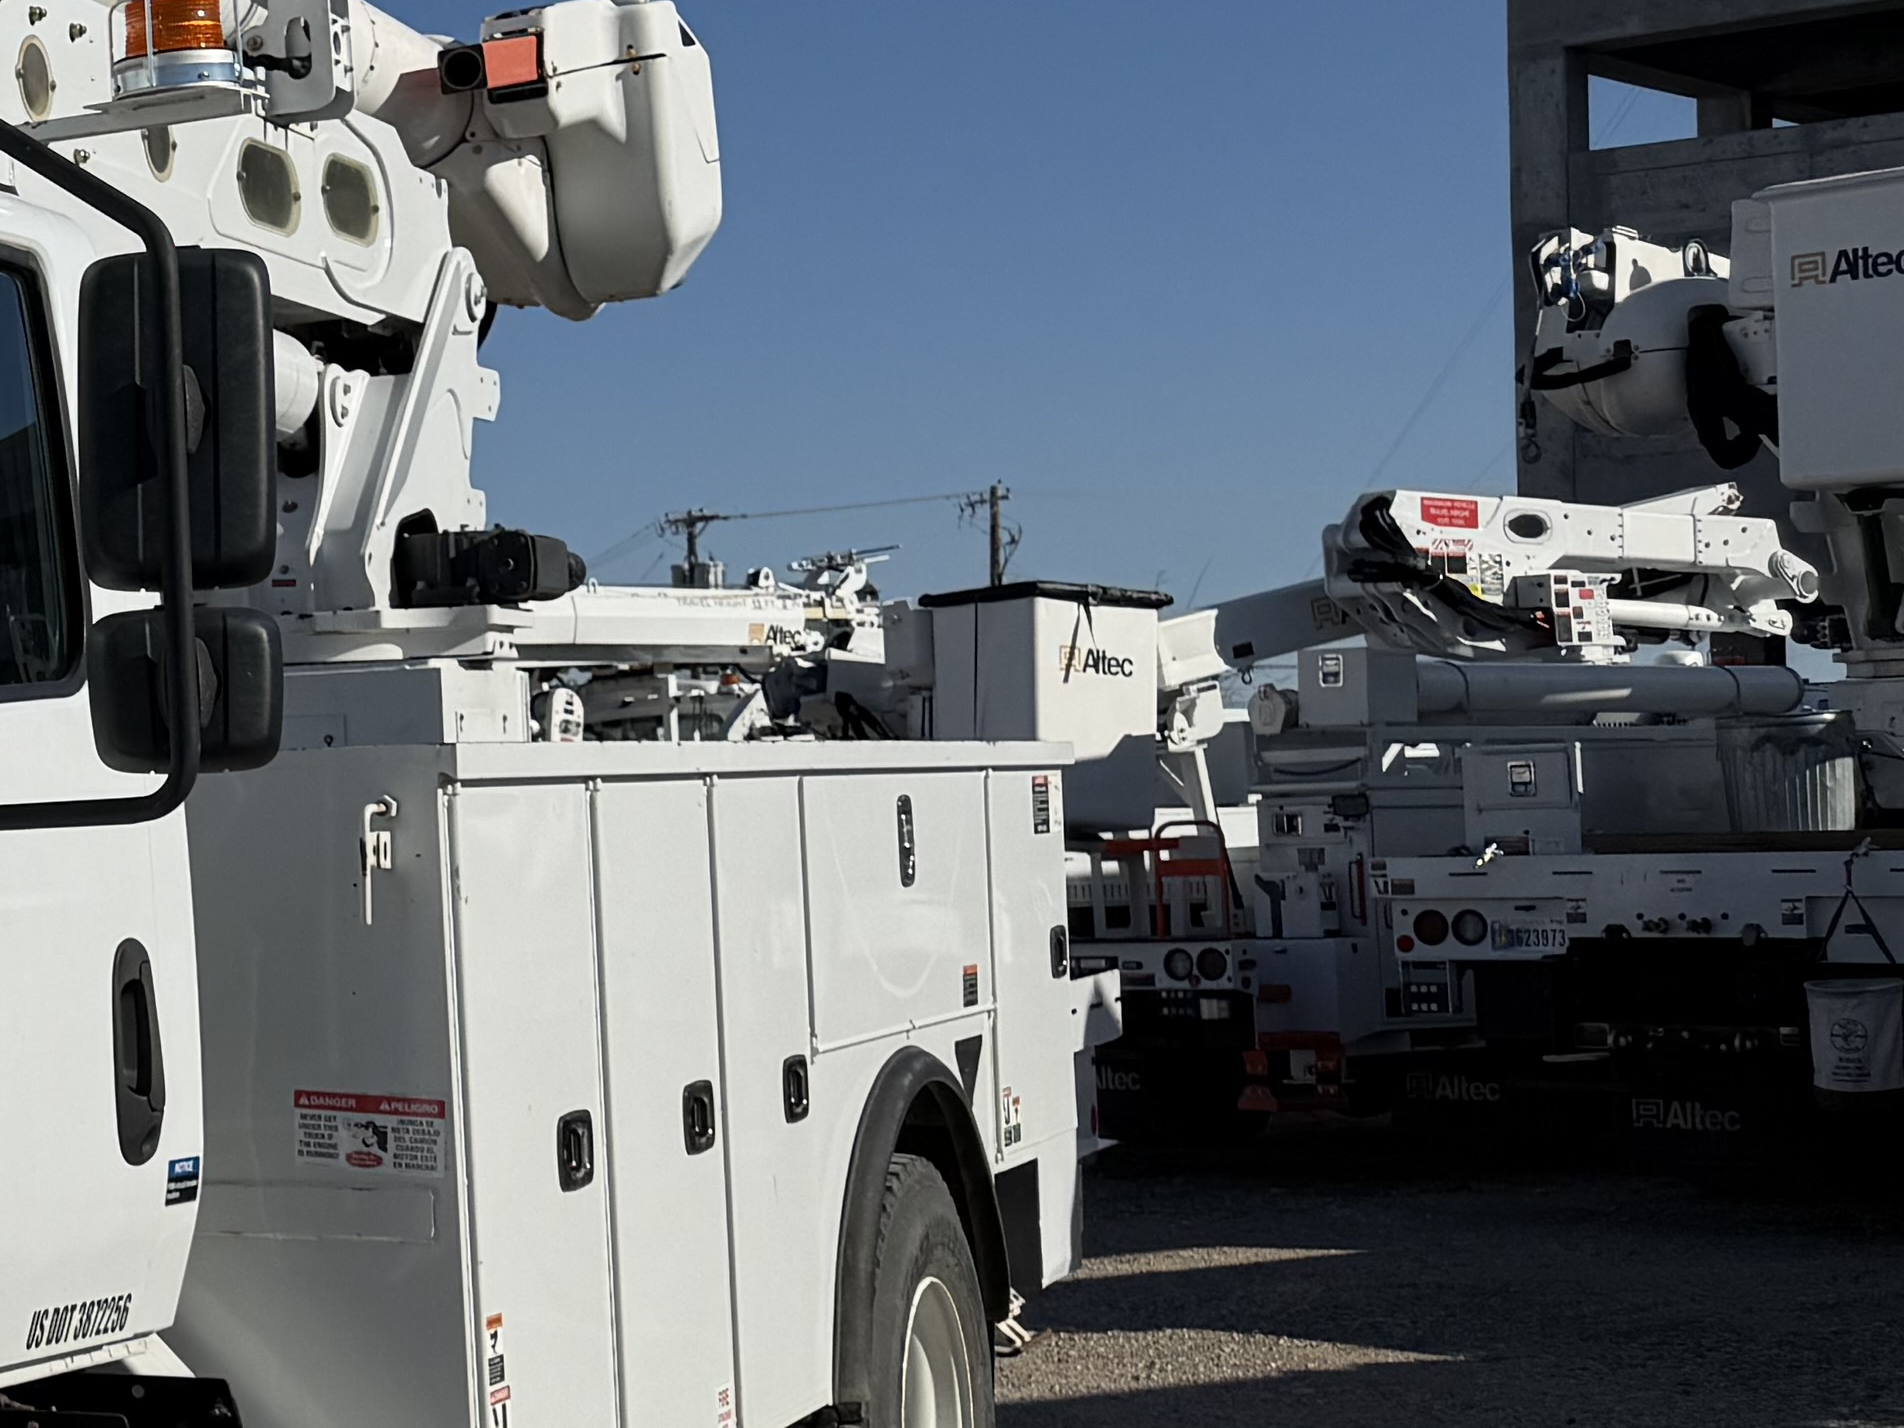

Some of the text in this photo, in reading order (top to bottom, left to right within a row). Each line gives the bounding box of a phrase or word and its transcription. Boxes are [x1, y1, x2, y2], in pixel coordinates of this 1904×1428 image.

[765, 624, 802, 646] Altec
[1083, 648, 1134, 677] Altec
[310, 1095, 356, 1108] DANGER
[1435, 1075, 1501, 1102] Altec
[391, 1102, 438, 1113] PELIGRO
[1666, 1100, 1741, 1132] Altec
[26, 1292, 132, 1350] US DOT 3872256
